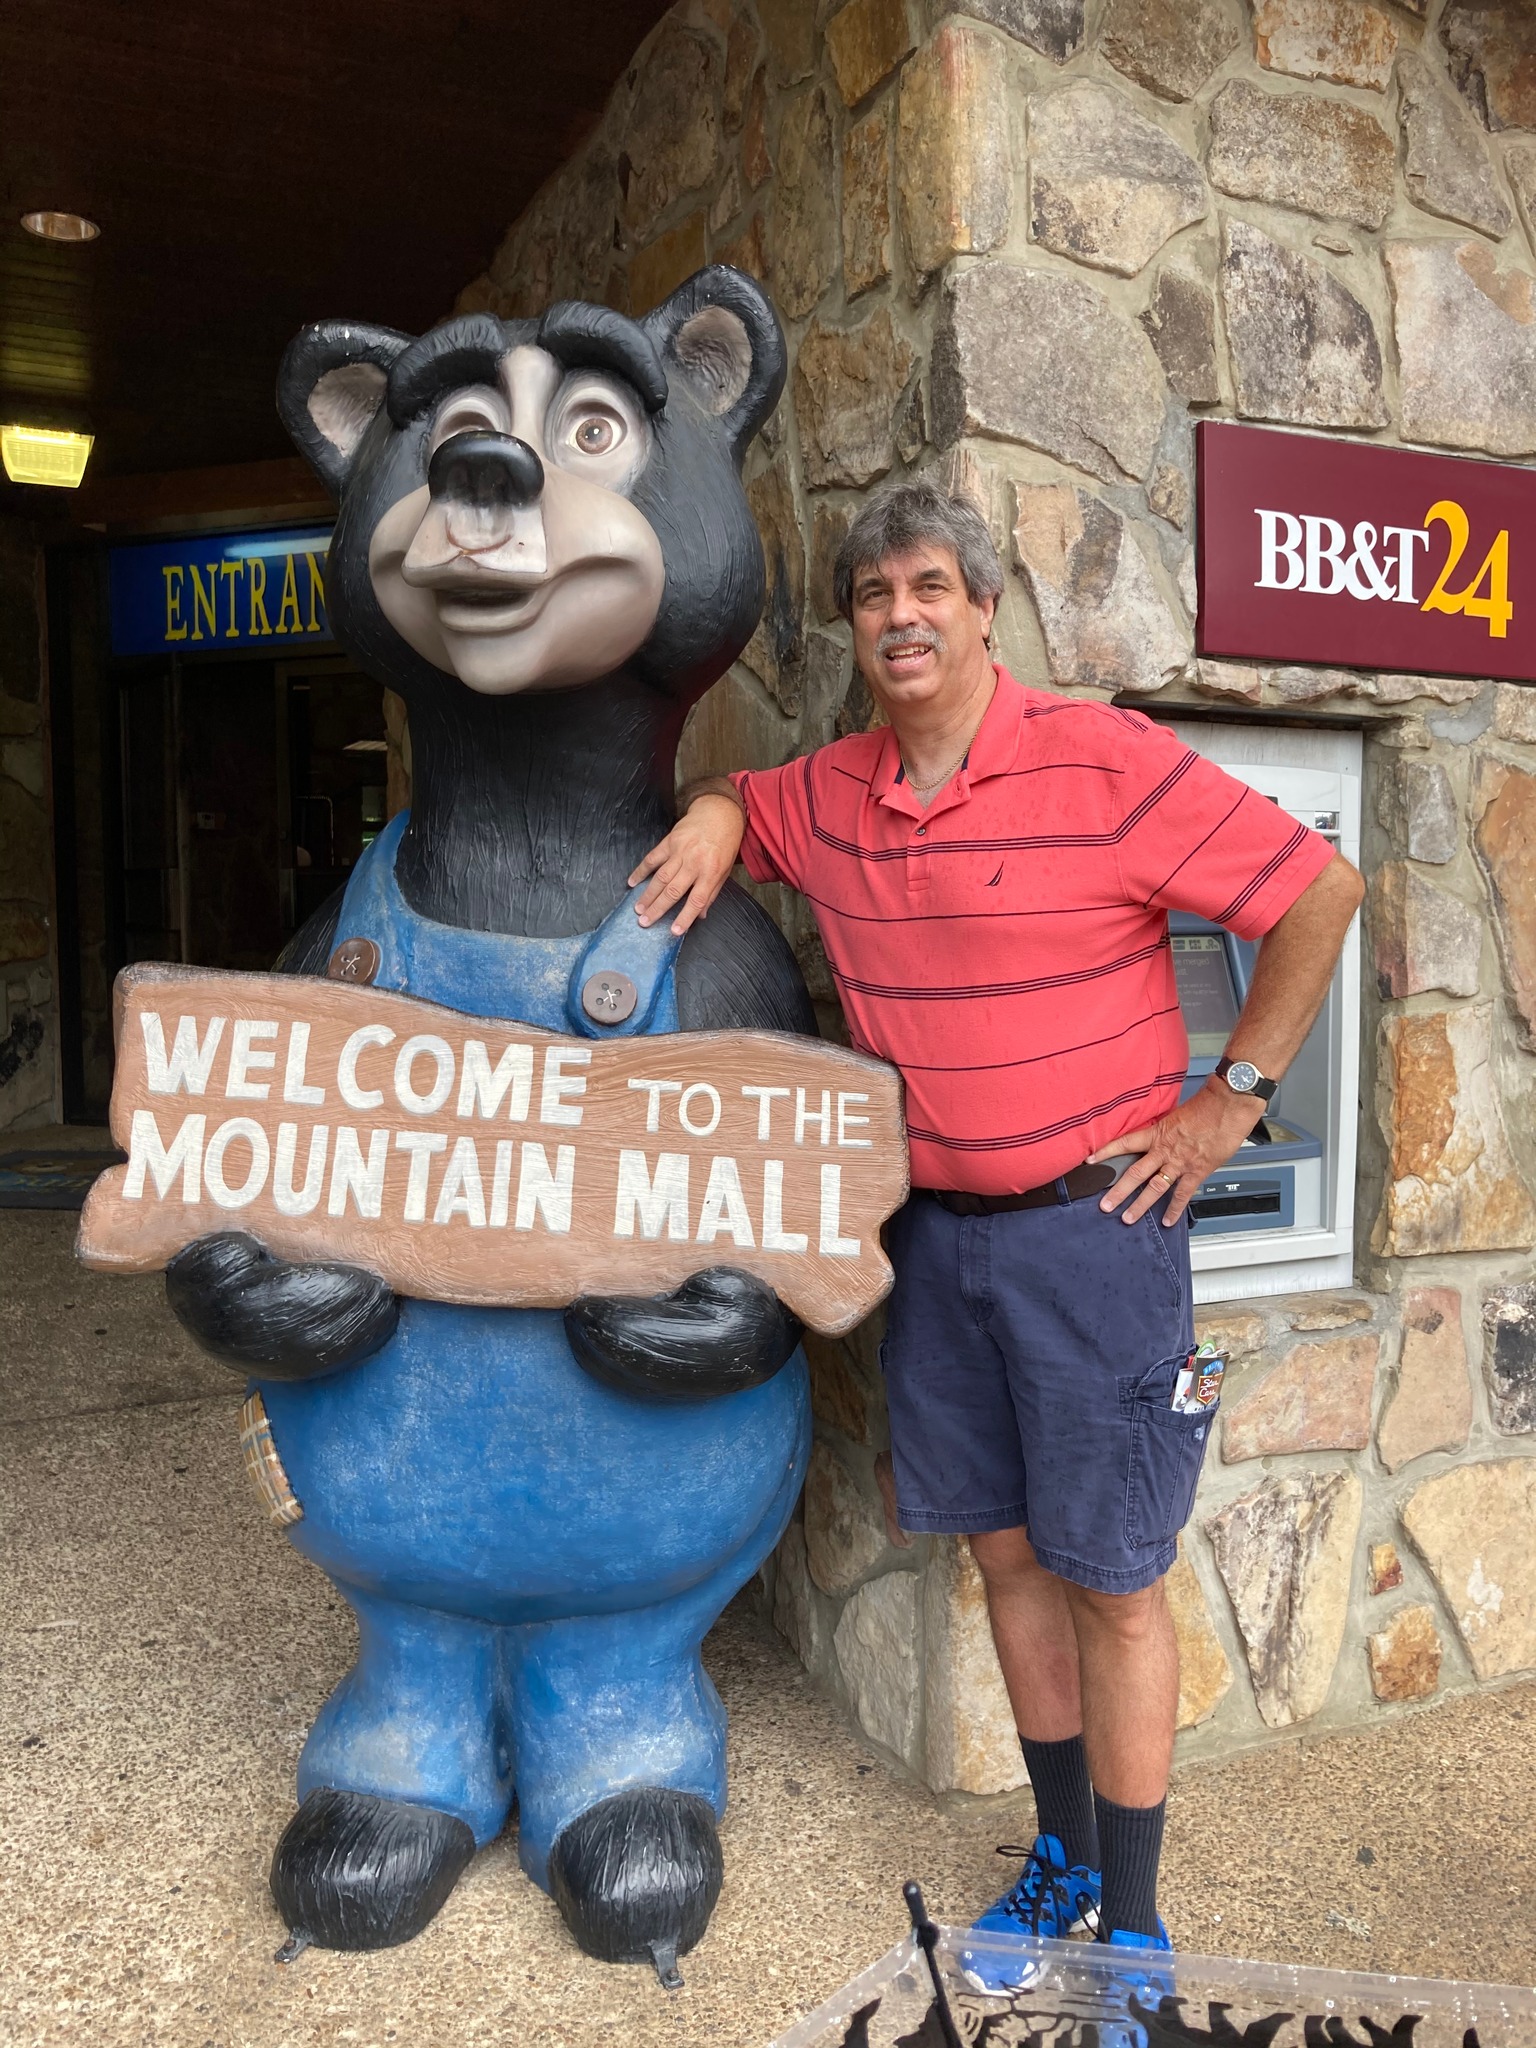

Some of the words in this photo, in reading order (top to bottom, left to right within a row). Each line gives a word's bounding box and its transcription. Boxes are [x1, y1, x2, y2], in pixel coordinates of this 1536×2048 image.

[140, 1012, 592, 1126] WELCOME
[628, 1078, 722, 1136] TO
[742, 1086, 873, 1147] THE
[122, 1110, 575, 1233] MOUNTAIN
[613, 1149, 861, 1256] MALL
